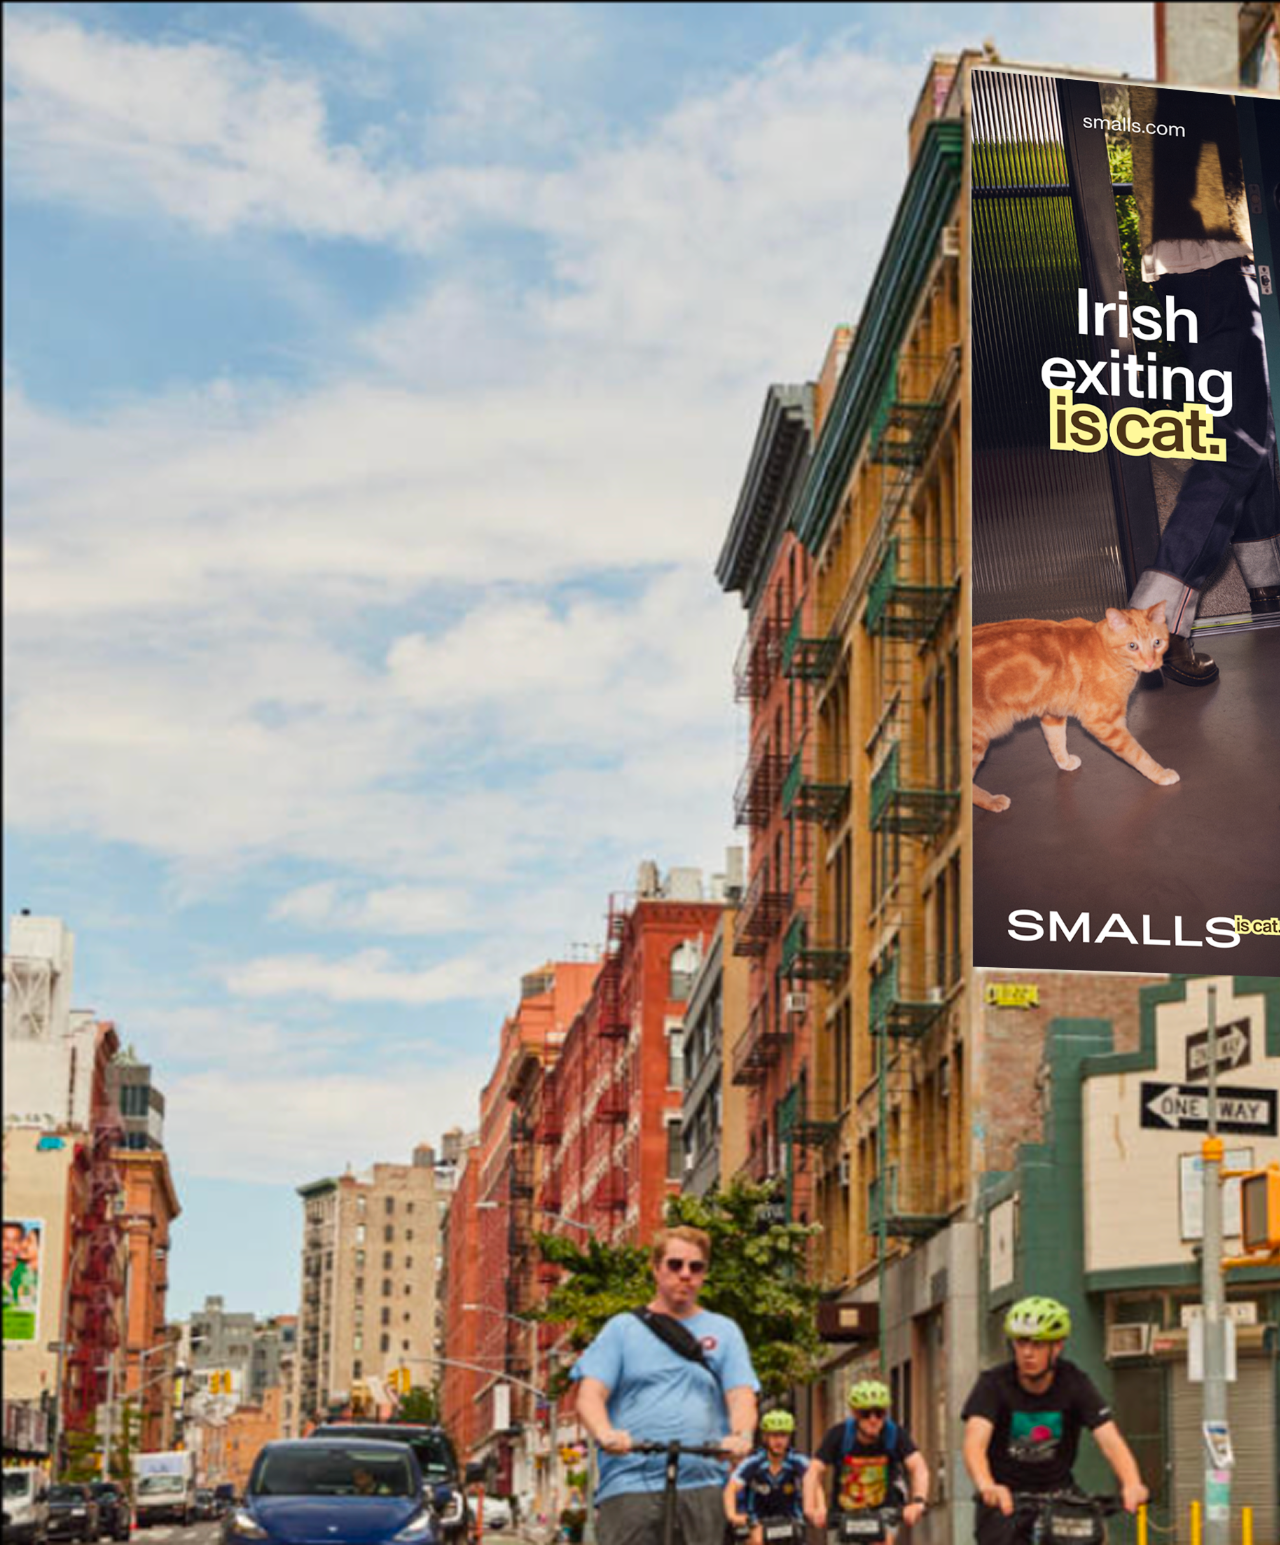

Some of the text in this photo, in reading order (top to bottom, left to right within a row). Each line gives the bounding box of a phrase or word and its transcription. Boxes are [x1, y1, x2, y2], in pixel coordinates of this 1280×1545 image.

[1083, 115, 1186, 138] smalls.com
[1077, 287, 1199, 344] Irish
[1041, 348, 1233, 417] exiting
[1056, 396, 1220, 455] is cat.
[1007, 908, 1240, 948] SMALLS
[1236, 917, 1250, 932] is
[1161, 1097, 1260, 1119] ONE WAY
